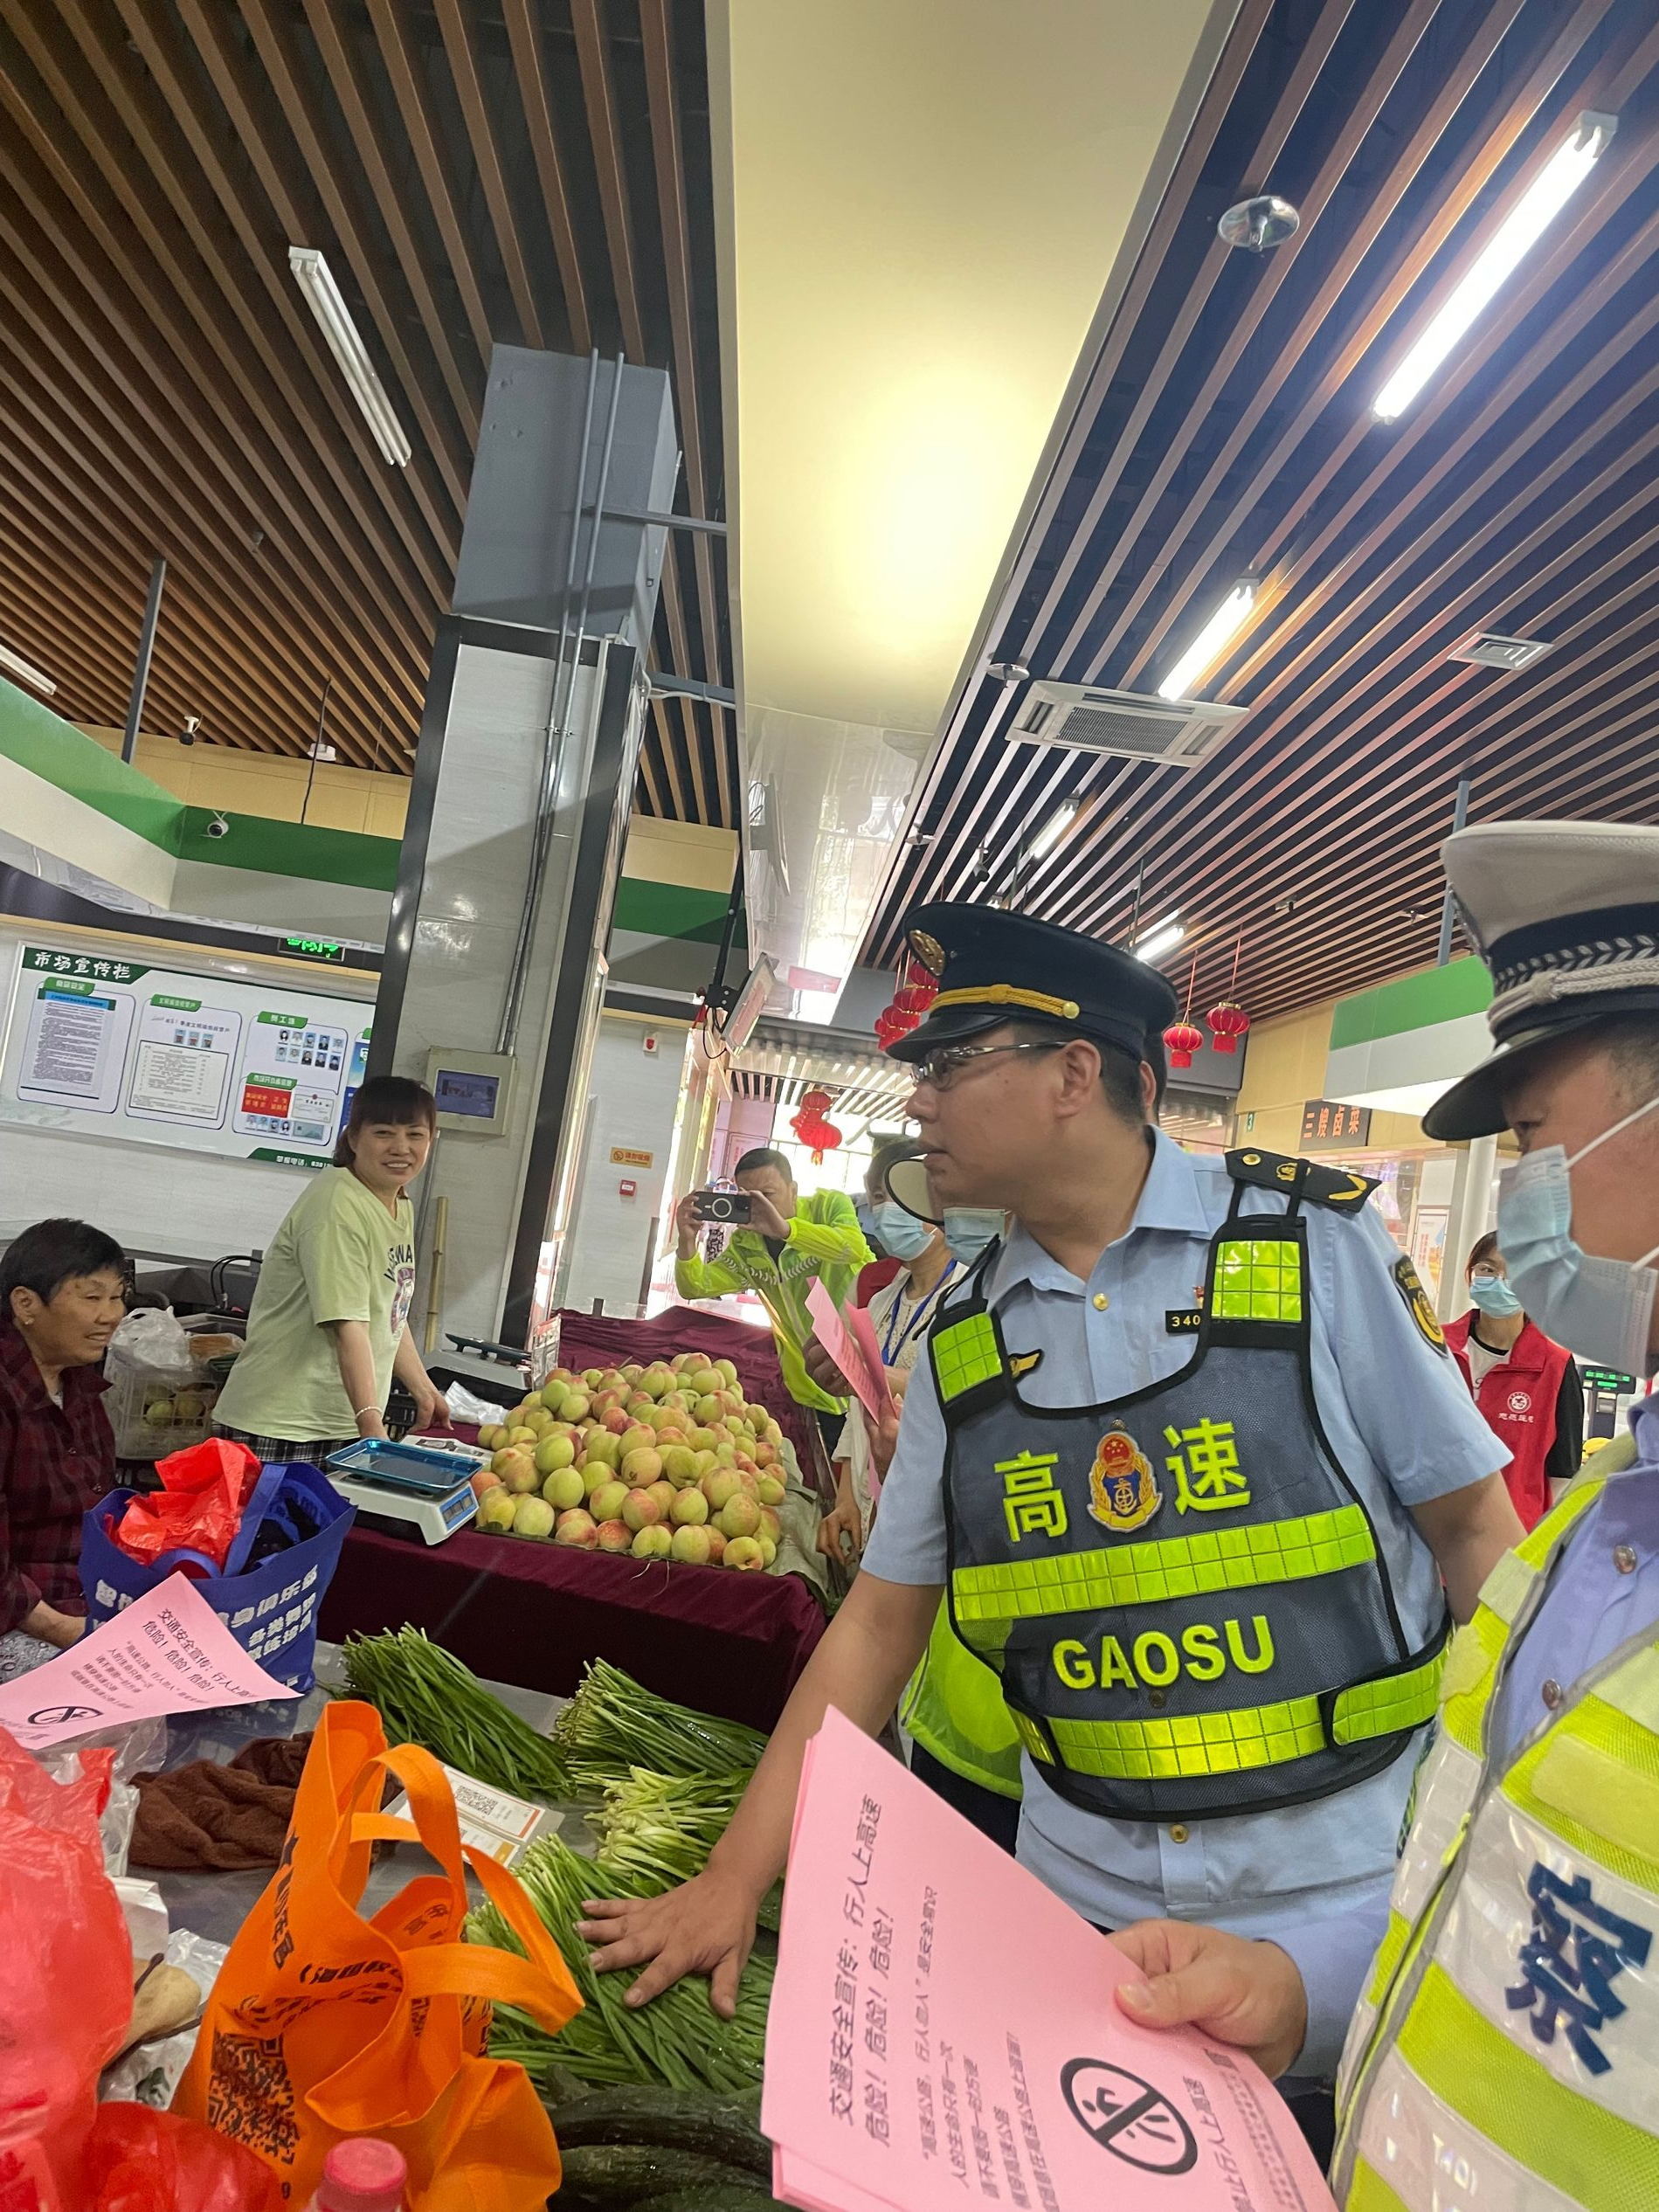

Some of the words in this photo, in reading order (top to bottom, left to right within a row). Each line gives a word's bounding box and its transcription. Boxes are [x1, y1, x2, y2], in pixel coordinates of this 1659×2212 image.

[35, 951, 130, 979] 市场宣传栏
[1052, 1615, 1275, 1690] GAOSU
[1504, 1860, 1653, 2077] 察
